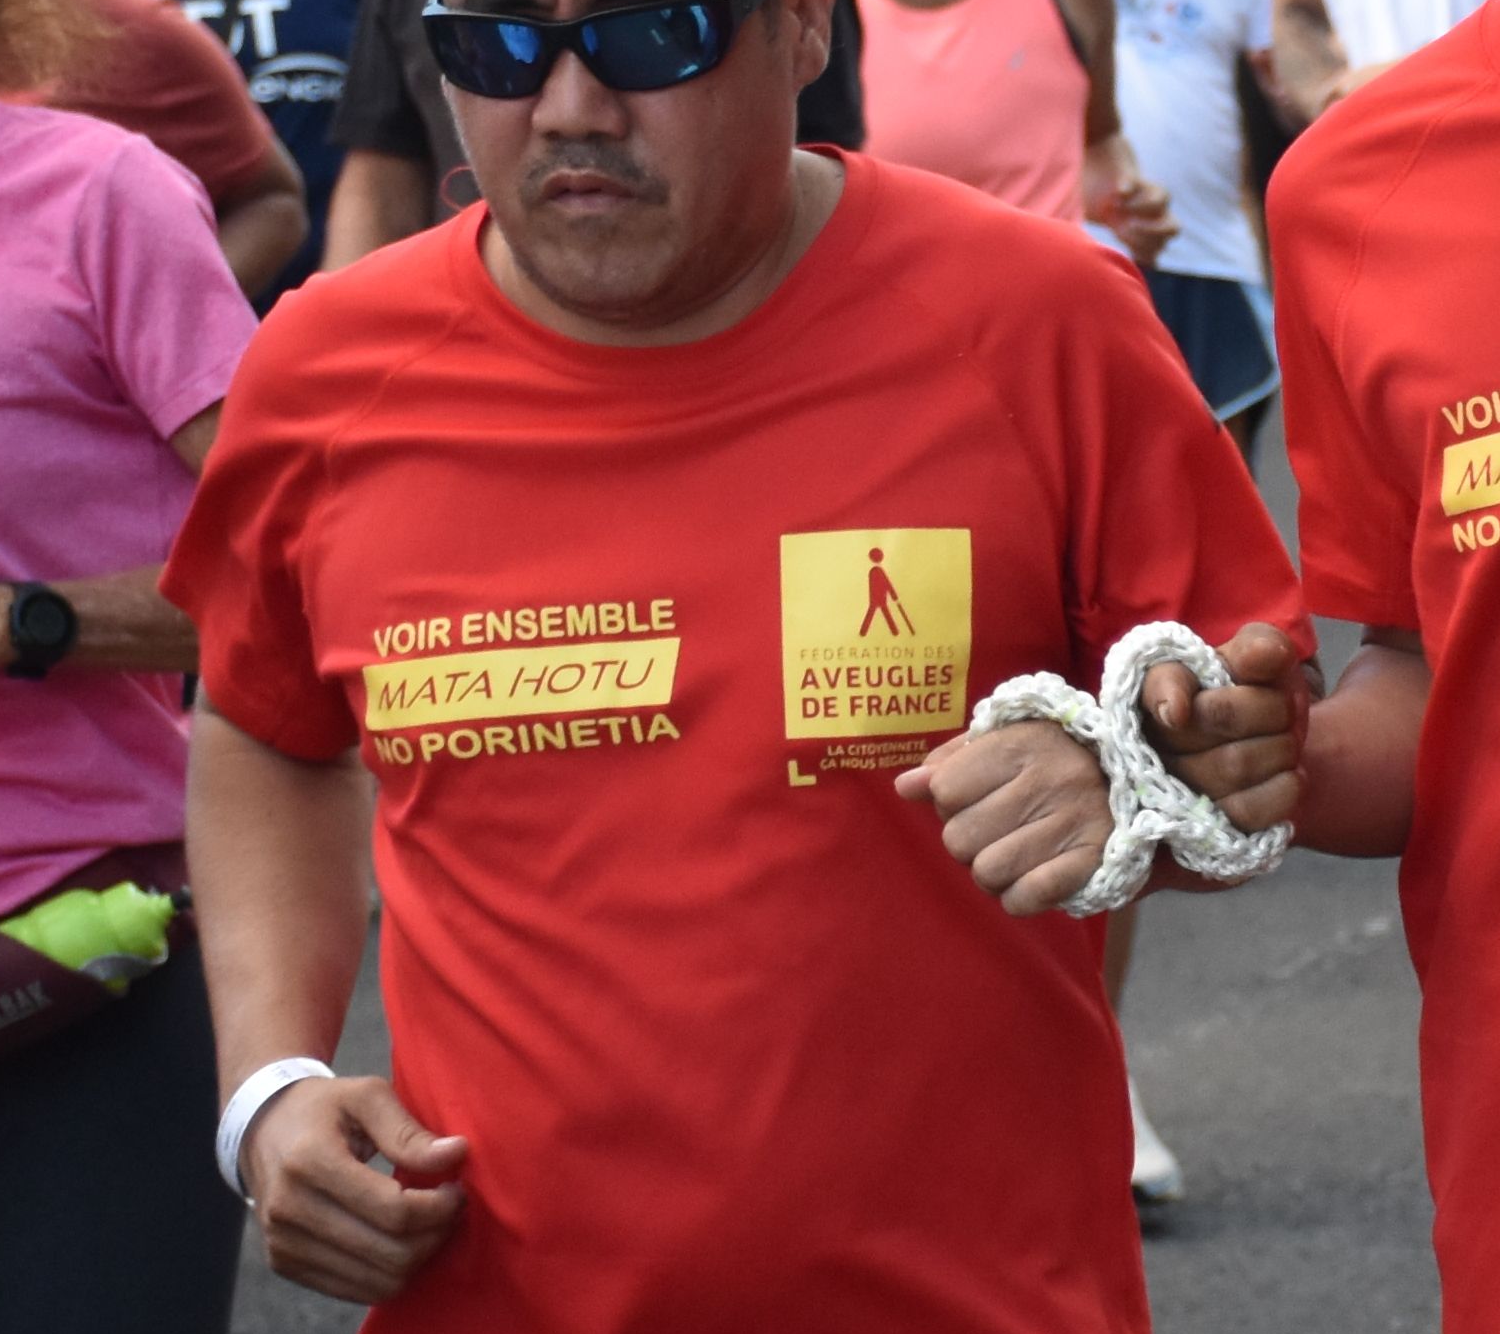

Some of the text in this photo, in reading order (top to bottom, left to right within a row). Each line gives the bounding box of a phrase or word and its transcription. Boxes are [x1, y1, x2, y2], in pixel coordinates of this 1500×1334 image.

[1452, 515, 1500, 553] NO
[373, 599, 675, 657] VOIR ENSEMBLE
[924, 646, 955, 659] DES
[378, 658, 654, 711] MATA HOTU
[800, 665, 953, 690] AVEUGLES
[802, 692, 951, 718] DE FRANCE
[374, 713, 680, 765] NO PORINETIA
[827, 745, 844, 756] LA
[840, 756, 876, 769] NOUS
